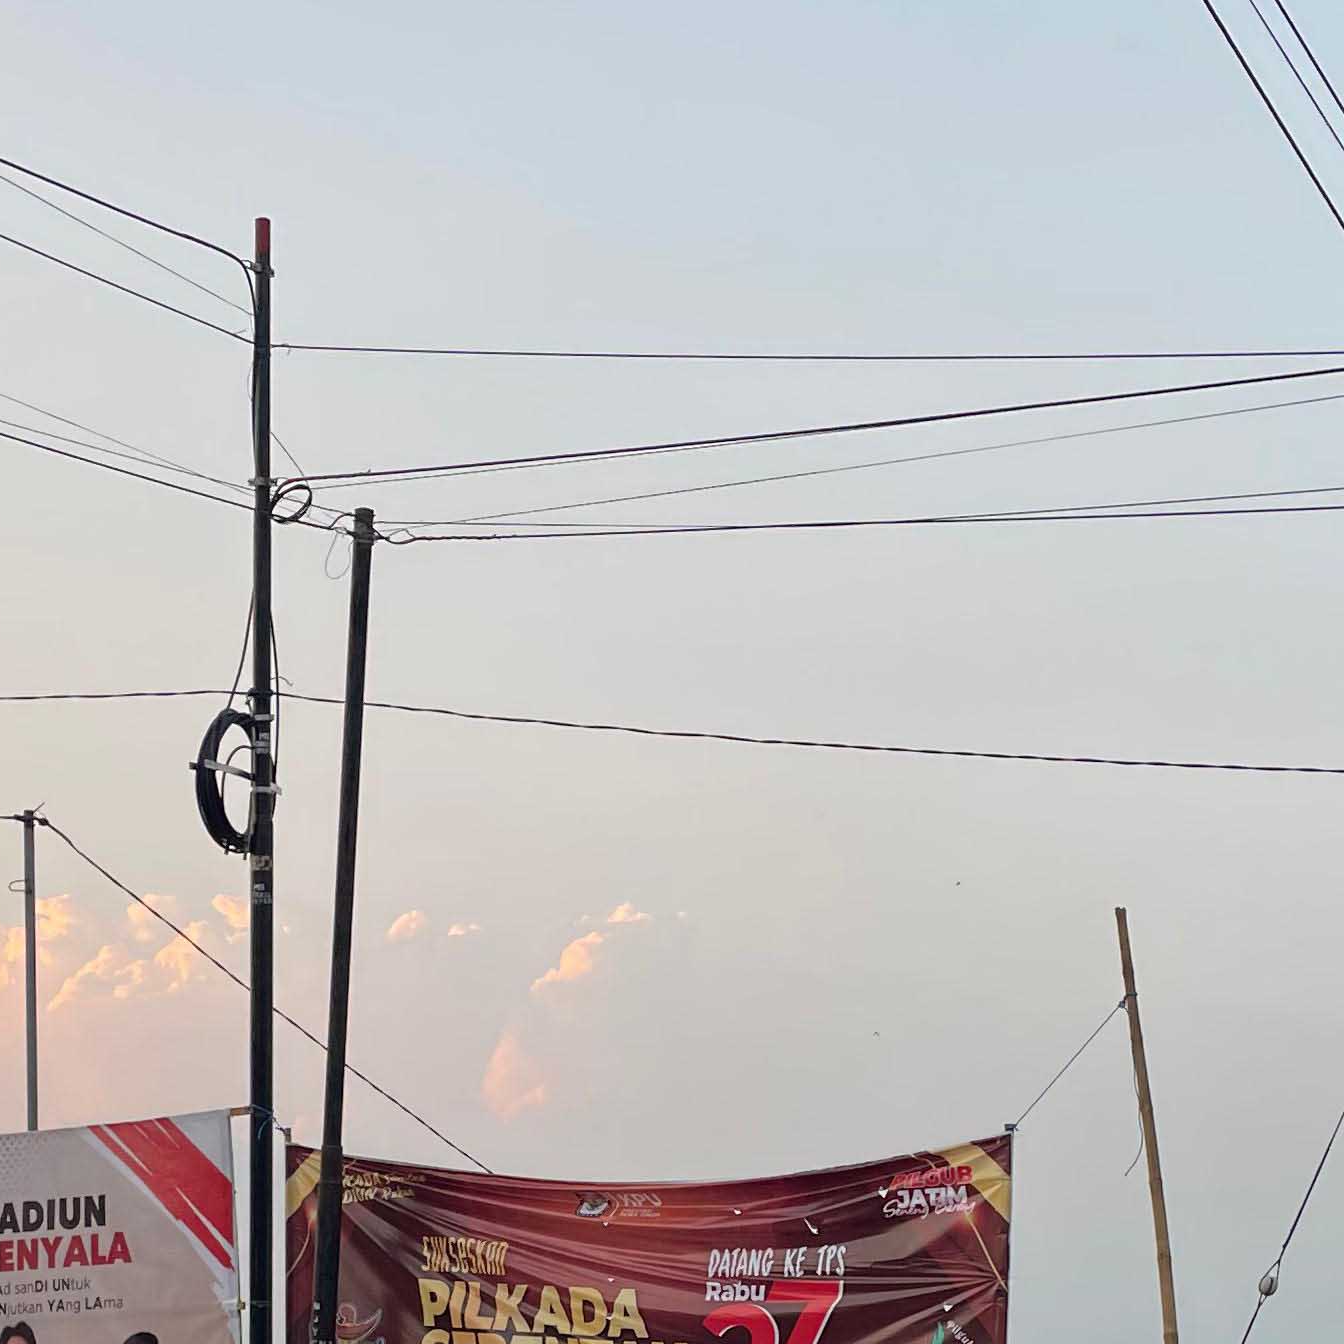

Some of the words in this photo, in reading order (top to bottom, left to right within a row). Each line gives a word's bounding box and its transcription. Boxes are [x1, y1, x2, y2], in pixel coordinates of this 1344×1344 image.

[888, 1165, 975, 1190] PILGUB
[896, 1184, 968, 1209] JATIM
[707, 1247, 774, 1278] DATANG
[783, 1246, 806, 1277] KE
[816, 1245, 847, 1277] TPS
[705, 1281, 766, 1302] Rabu
[418, 1278, 649, 1339] PILKADA
